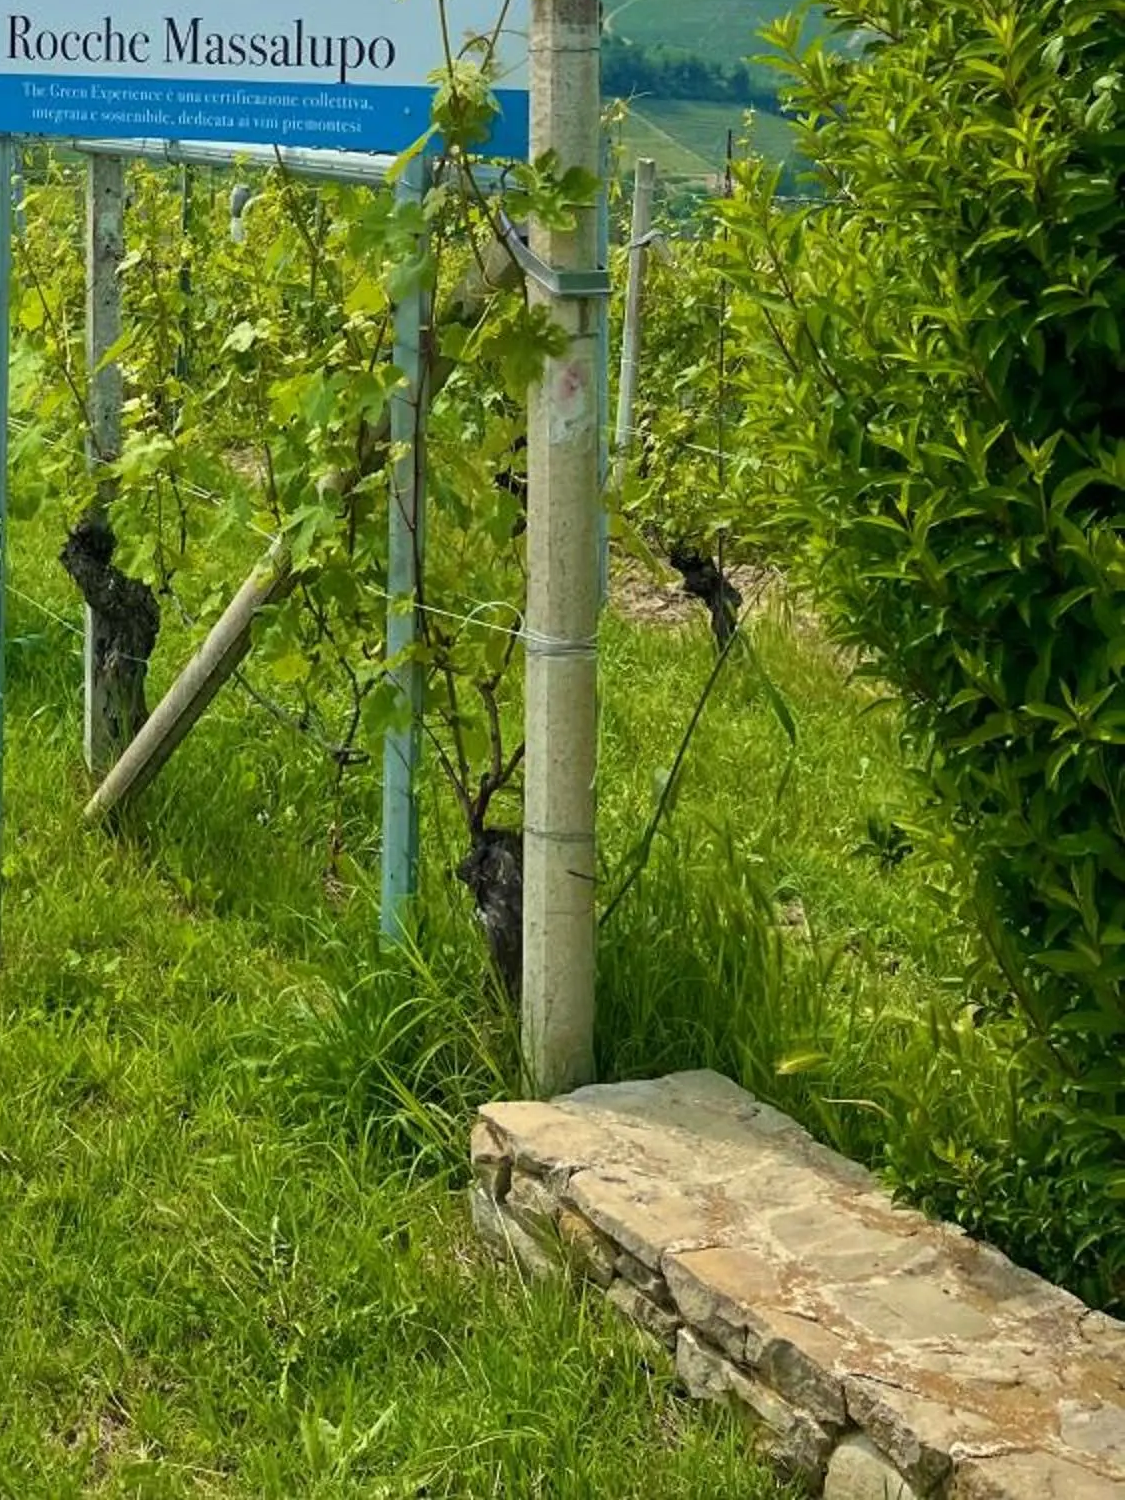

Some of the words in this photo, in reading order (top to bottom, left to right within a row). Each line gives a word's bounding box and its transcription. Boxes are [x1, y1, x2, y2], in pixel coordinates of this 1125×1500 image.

[7, 15, 150, 63] Rocche
[163, 17, 396, 84] Massalupo
[22, 81, 45, 98] The
[50, 83, 88, 99] Green
[91, 84, 162, 104] Experience
[178, 91, 202, 103] una
[204, 89, 299, 107] certificazione
[302, 92, 375, 111] collettiva,
[32, 108, 88, 123] integrata
[101, 109, 176, 125] sostenibile,
[179, 111, 234, 128] dedicata
[238, 116, 251, 128] ai
[254, 115, 279, 129] vini
[282, 116, 363, 135] piemontesi
